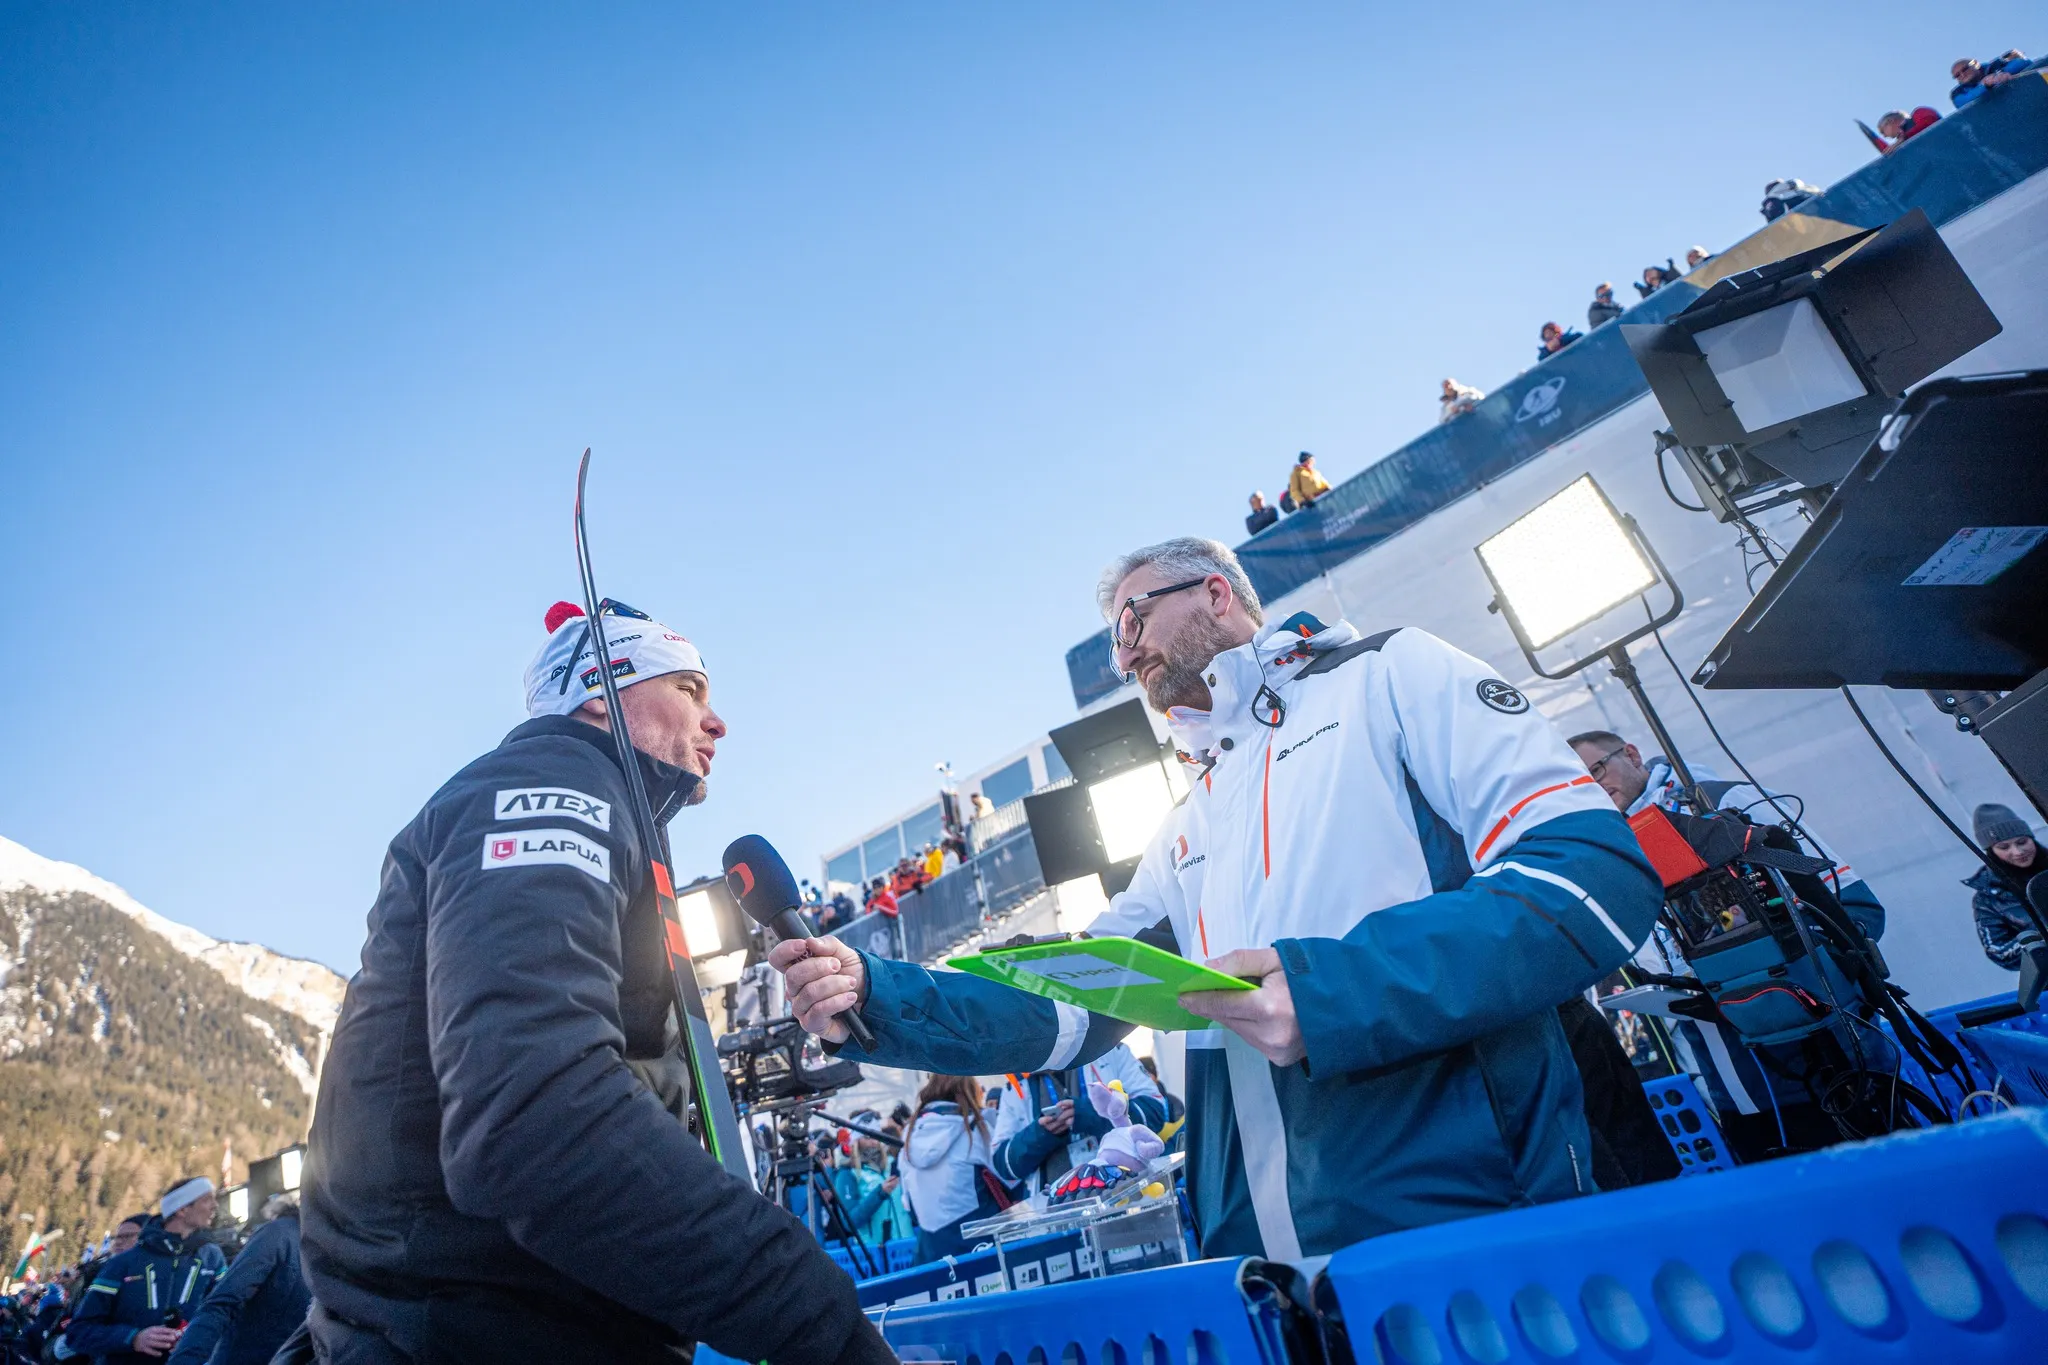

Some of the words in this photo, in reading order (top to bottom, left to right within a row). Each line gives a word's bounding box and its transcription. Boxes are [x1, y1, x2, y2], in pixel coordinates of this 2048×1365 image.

[1539, 407, 1562, 427] IBU
[609, 634, 642, 647] PRO
[1276, 734, 1315, 761] ALPINE
[1316, 722, 1339, 736] PRO
[501, 792, 604, 824] ATEX
[523, 840, 603, 868] LAPUA
